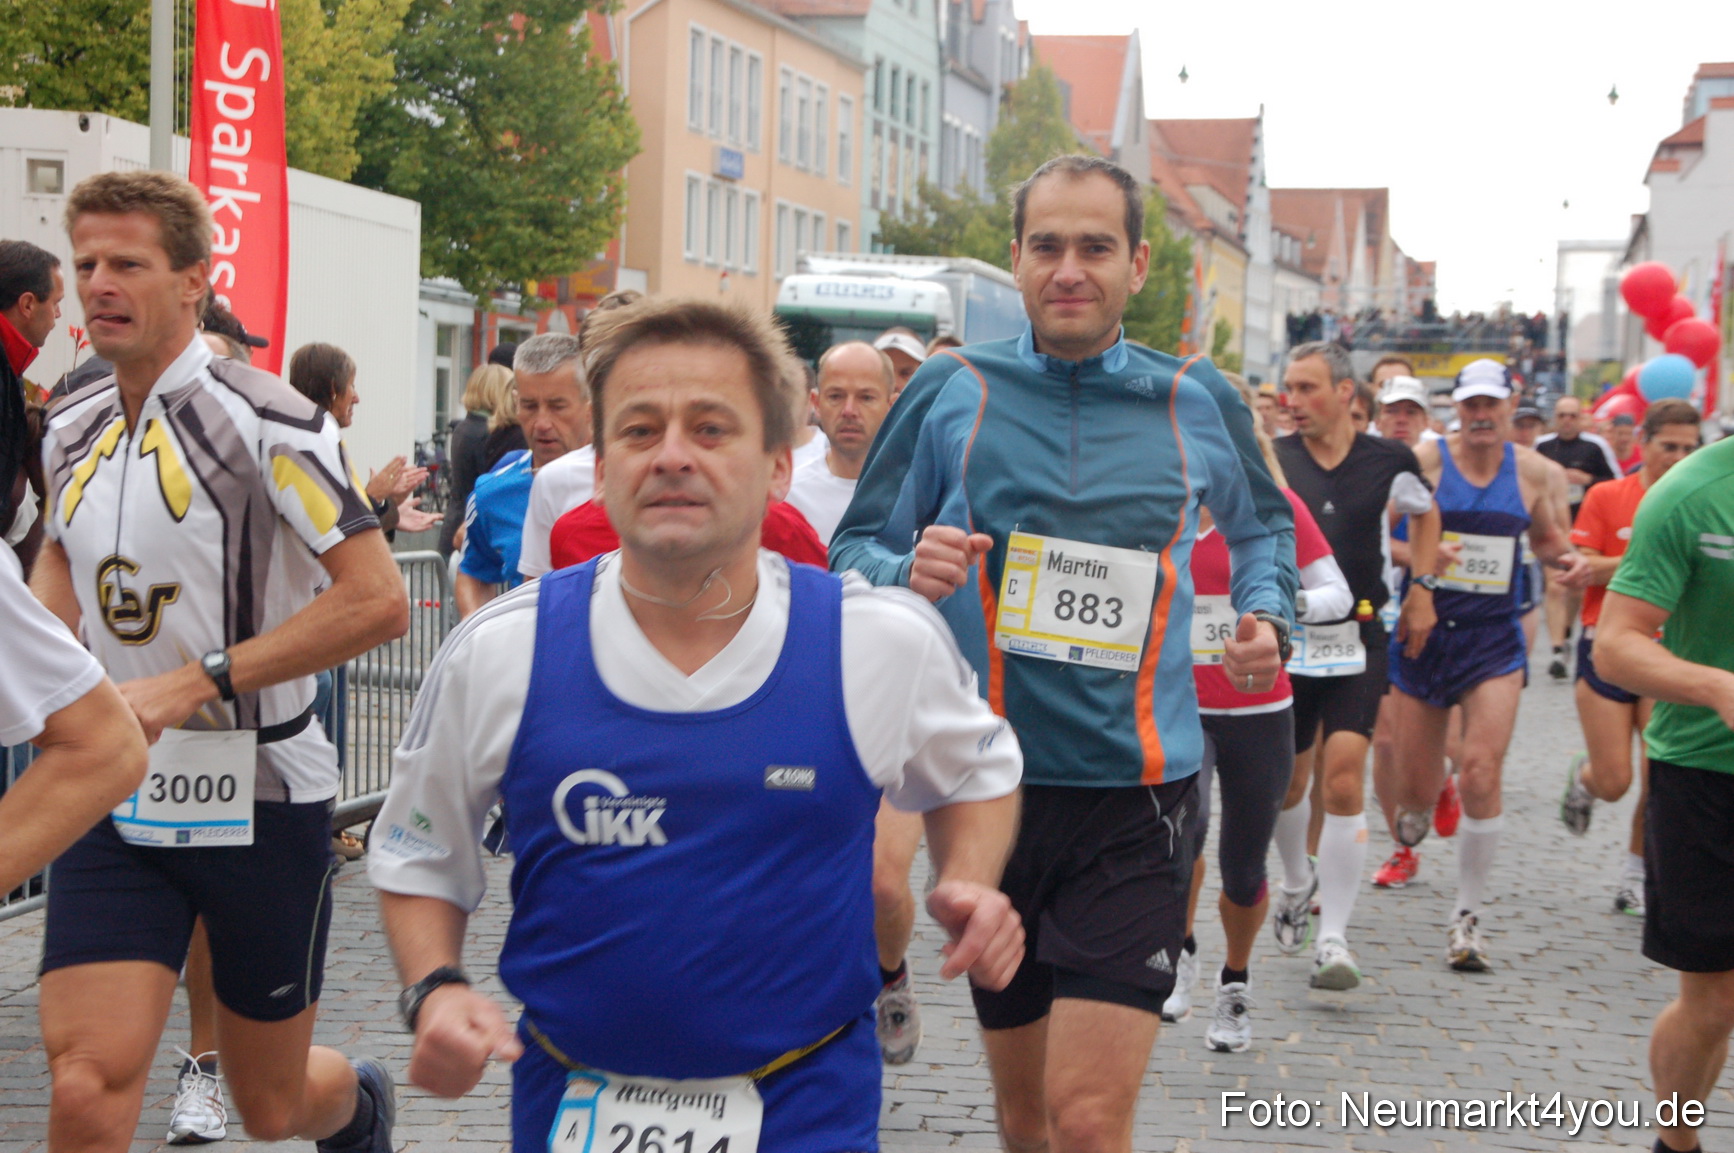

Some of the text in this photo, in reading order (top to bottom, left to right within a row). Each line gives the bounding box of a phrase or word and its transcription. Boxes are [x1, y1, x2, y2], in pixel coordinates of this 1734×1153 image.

[203, 41, 271, 314] Sparkas
[1047, 549, 1109, 580] Martin
[1466, 558, 1500, 576] 892
[1008, 578, 1019, 596] C
[1054, 589, 1124, 629] 883
[1085, 647, 1138, 663] PFLEIDERER
[1311, 643, 1357, 659] 2038
[149, 772, 236, 804] 3000
[565, 1119, 578, 1142] A
